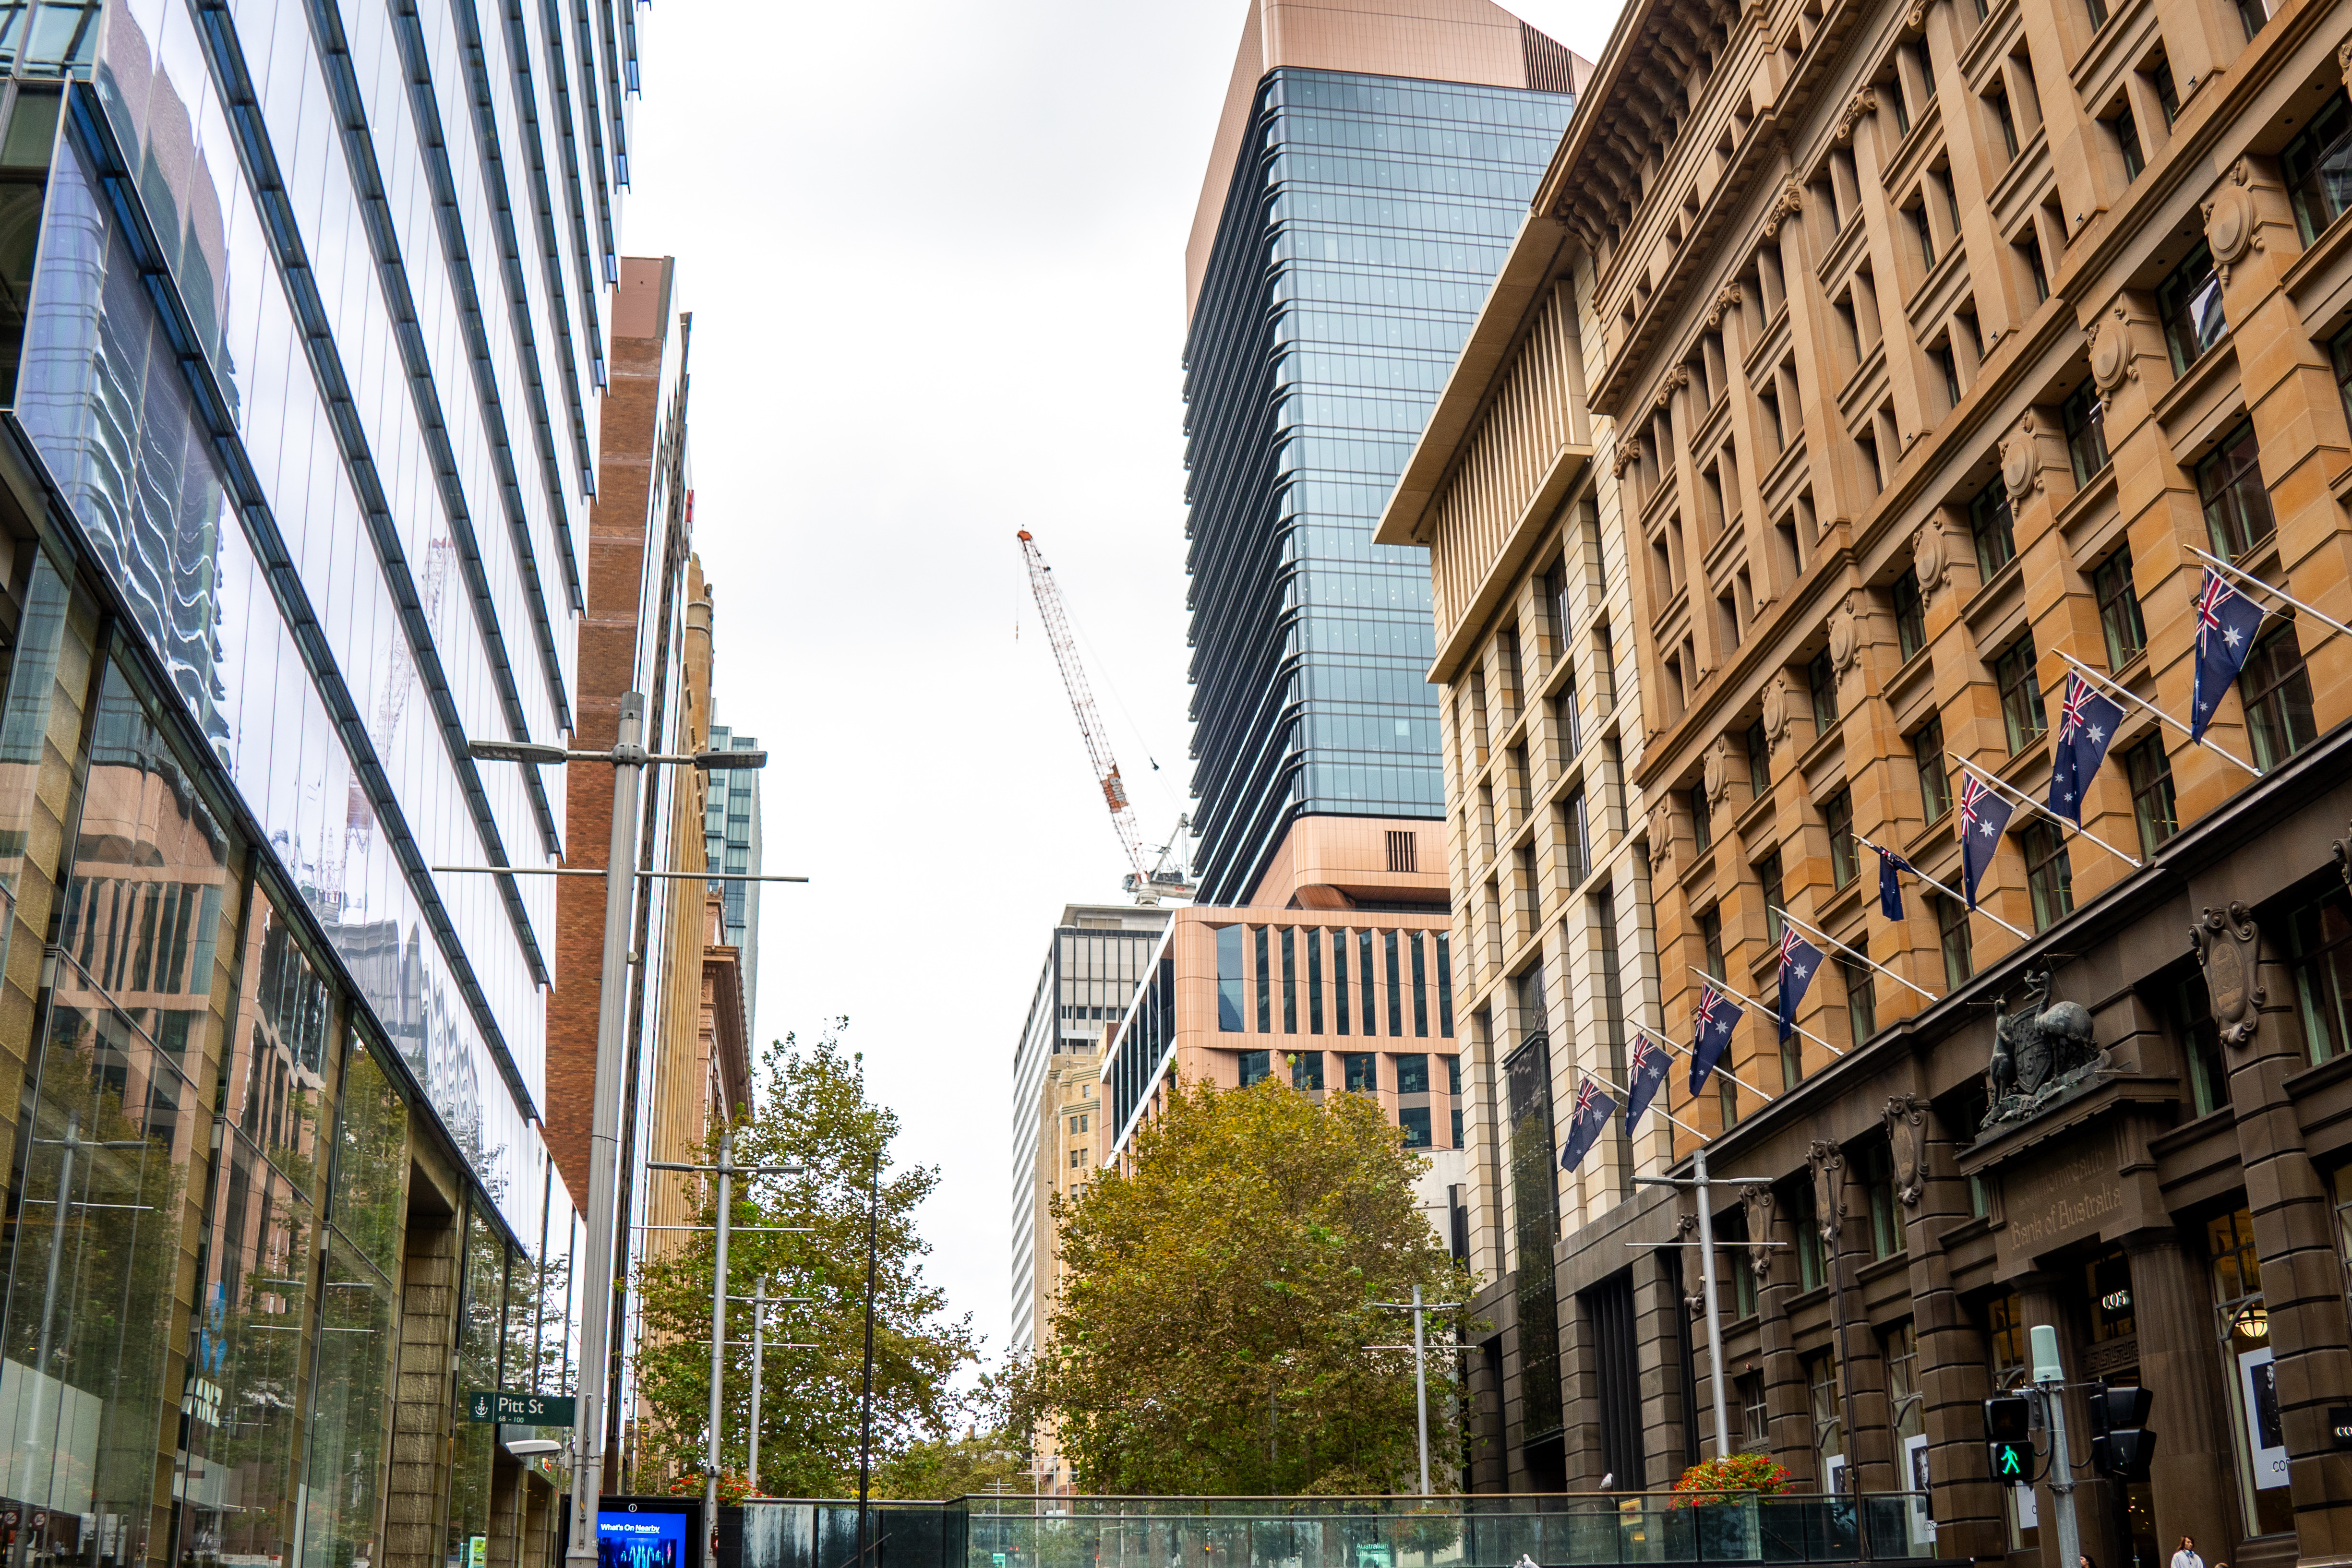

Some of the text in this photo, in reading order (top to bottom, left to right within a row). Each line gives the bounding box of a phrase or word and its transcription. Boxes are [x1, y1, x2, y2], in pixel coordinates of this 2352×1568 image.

[2010, 1183, 2123, 1250] Bank of Australia
[2102, 1290, 2128, 1309] COS
[499, 1397, 544, 1414] Pitt St
[635, 1525, 660, 1533] Nearby
